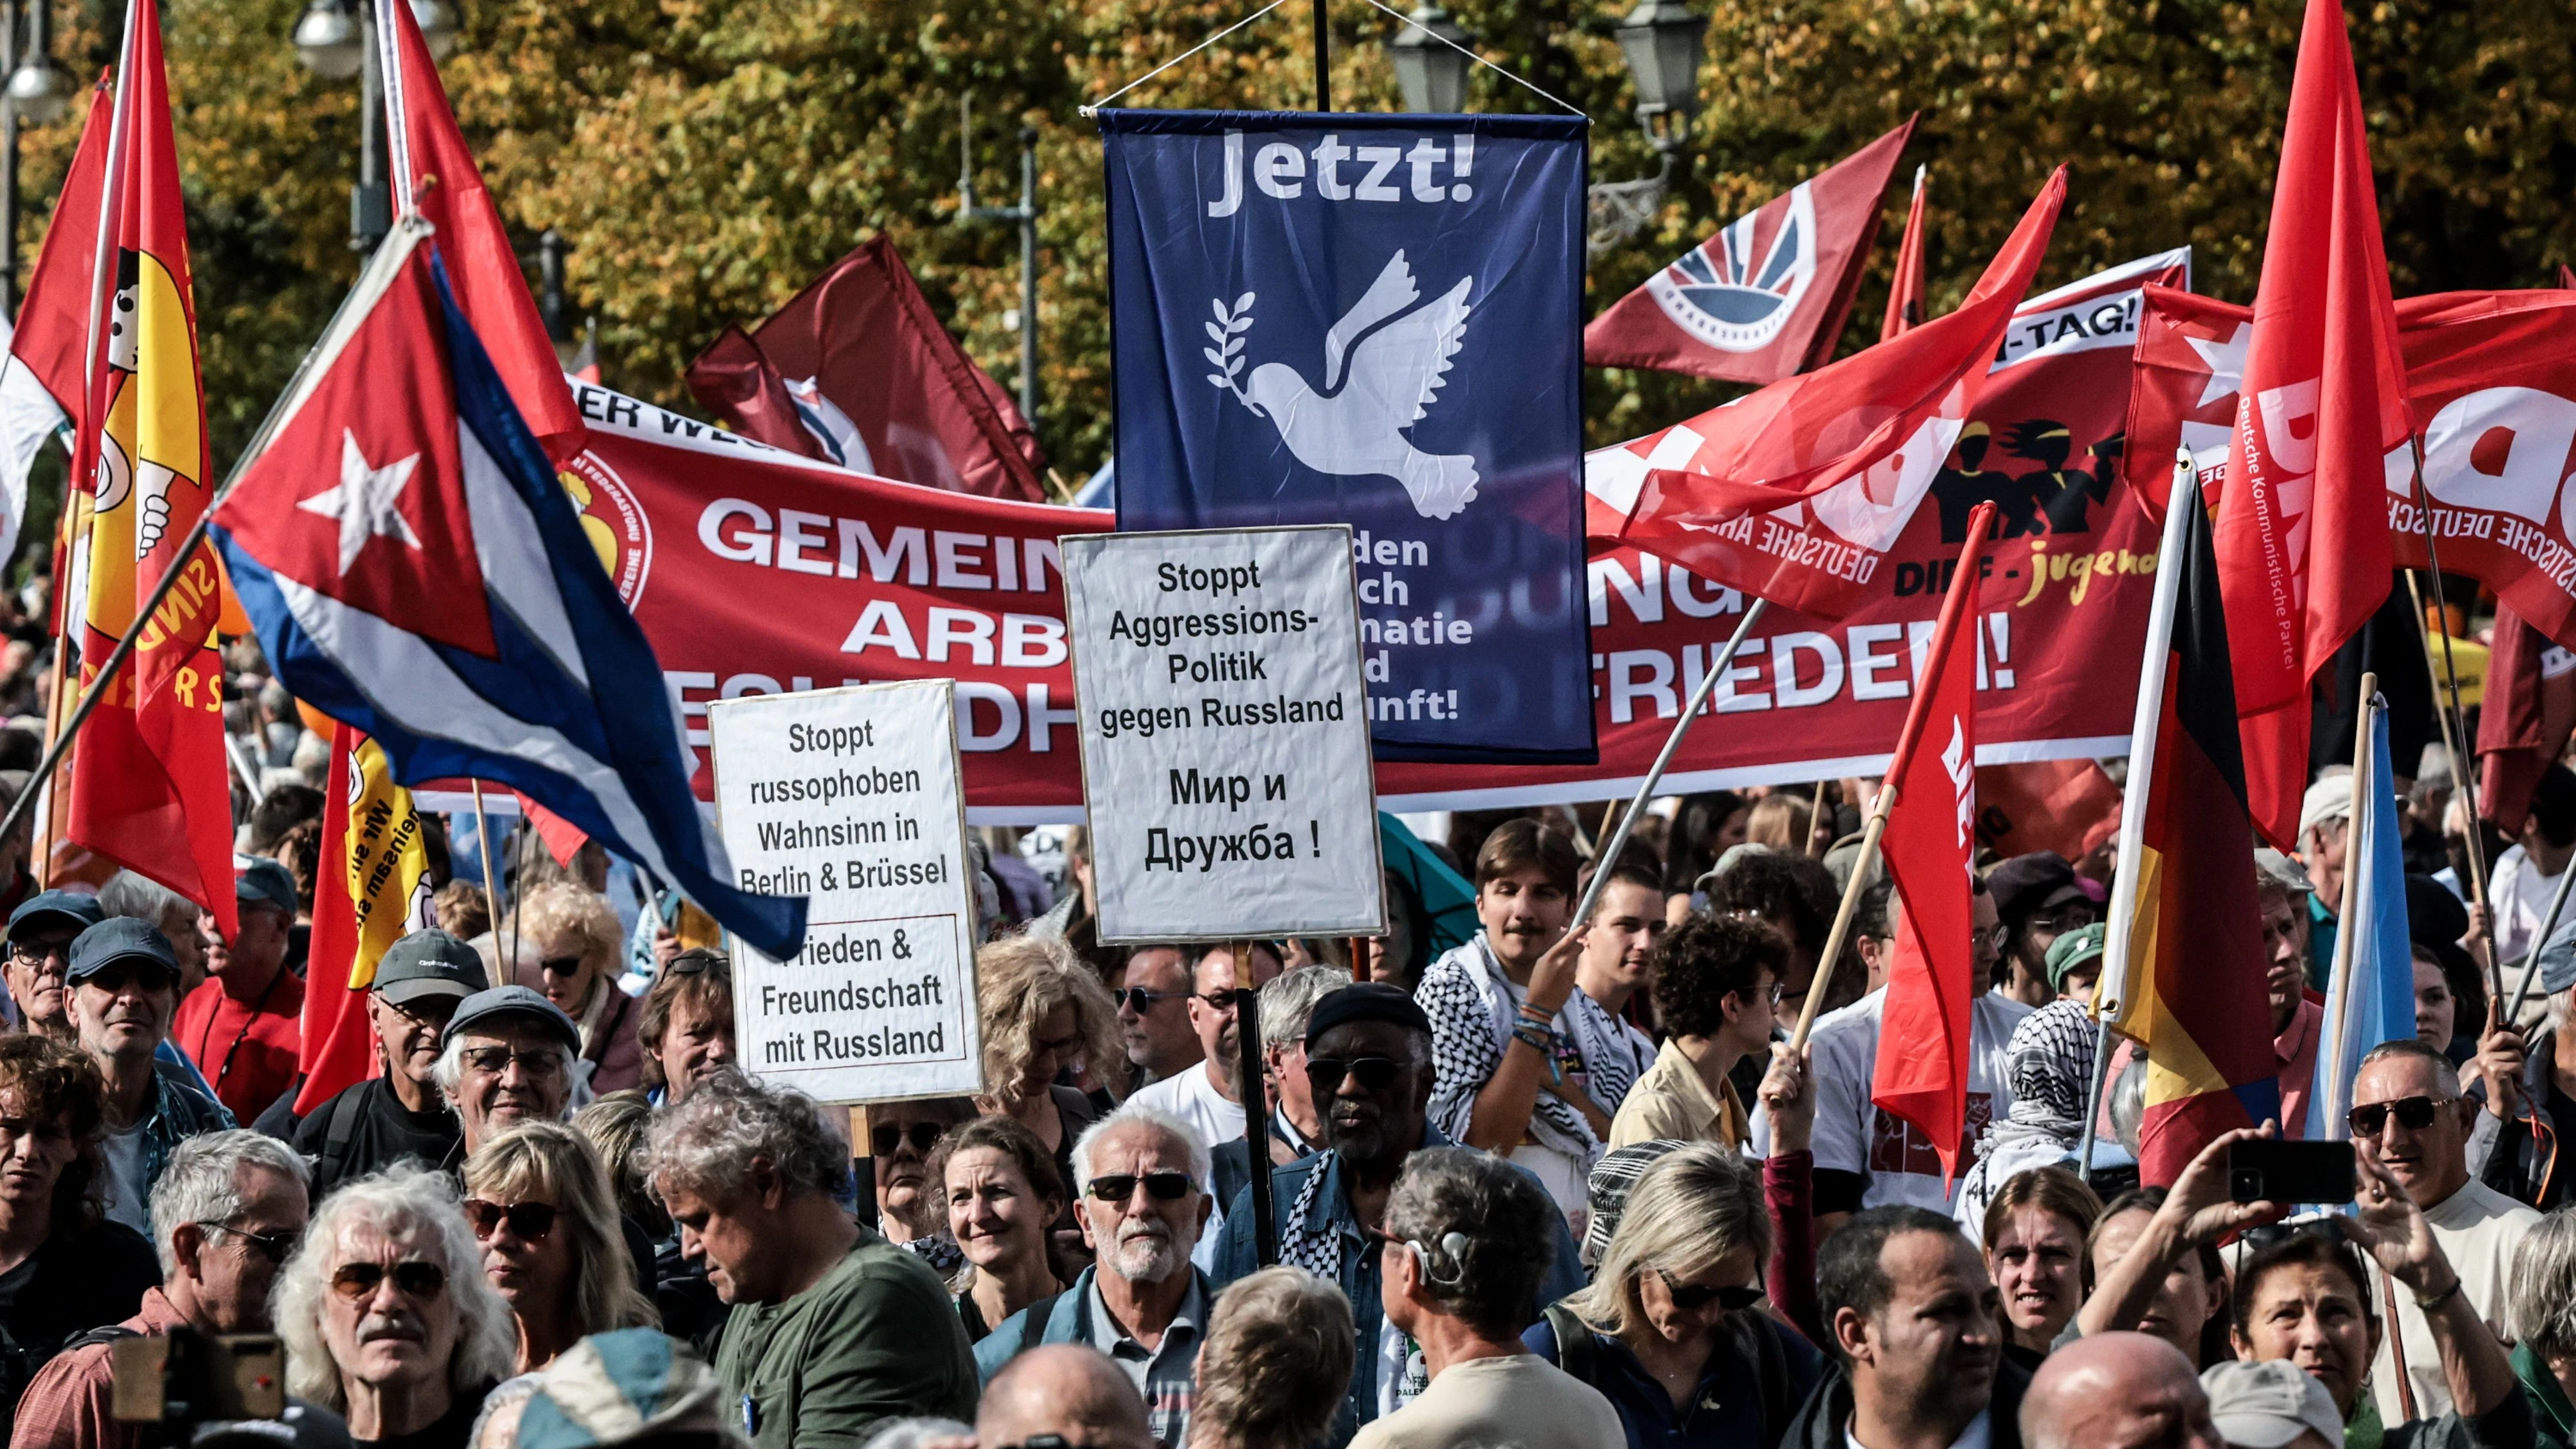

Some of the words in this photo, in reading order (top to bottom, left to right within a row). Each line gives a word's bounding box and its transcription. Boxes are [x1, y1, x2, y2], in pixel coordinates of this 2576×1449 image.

[1208, 129, 1474, 216] Jetzt!
[568, 383, 641, 427] ER
[1352, 530, 1428, 567] den
[2238, 396, 2260, 474] Deutsche
[2251, 476, 2287, 617] Kommunistische
[2278, 620, 2296, 671] Partei
[1157, 560, 1261, 597] Stoppt
[1358, 572, 1408, 606] ch
[1109, 605, 1319, 647] Aggressions-
[1169, 651, 1267, 683] Politik
[1101, 705, 1191, 738] gegen
[1201, 693, 1344, 727] Russland
[789, 719, 874, 756] Stoppt
[750, 768, 920, 806] russophoben
[1170, 768, 1250, 812] Мир
[1264, 773, 1286, 802] и
[757, 818, 886, 852] Wahnsinn
[896, 812, 919, 840] in
[1145, 822, 1295, 872] Дружба
[741, 866, 811, 896] Berlin
[820, 862, 839, 891] &
[847, 854, 948, 888] Brüssel
[782, 932, 883, 967] rieden
[892, 929, 912, 960] &
[762, 974, 943, 1016] Freundschaft
[765, 1035, 805, 1064] mit
[814, 1022, 945, 1060] Russland
